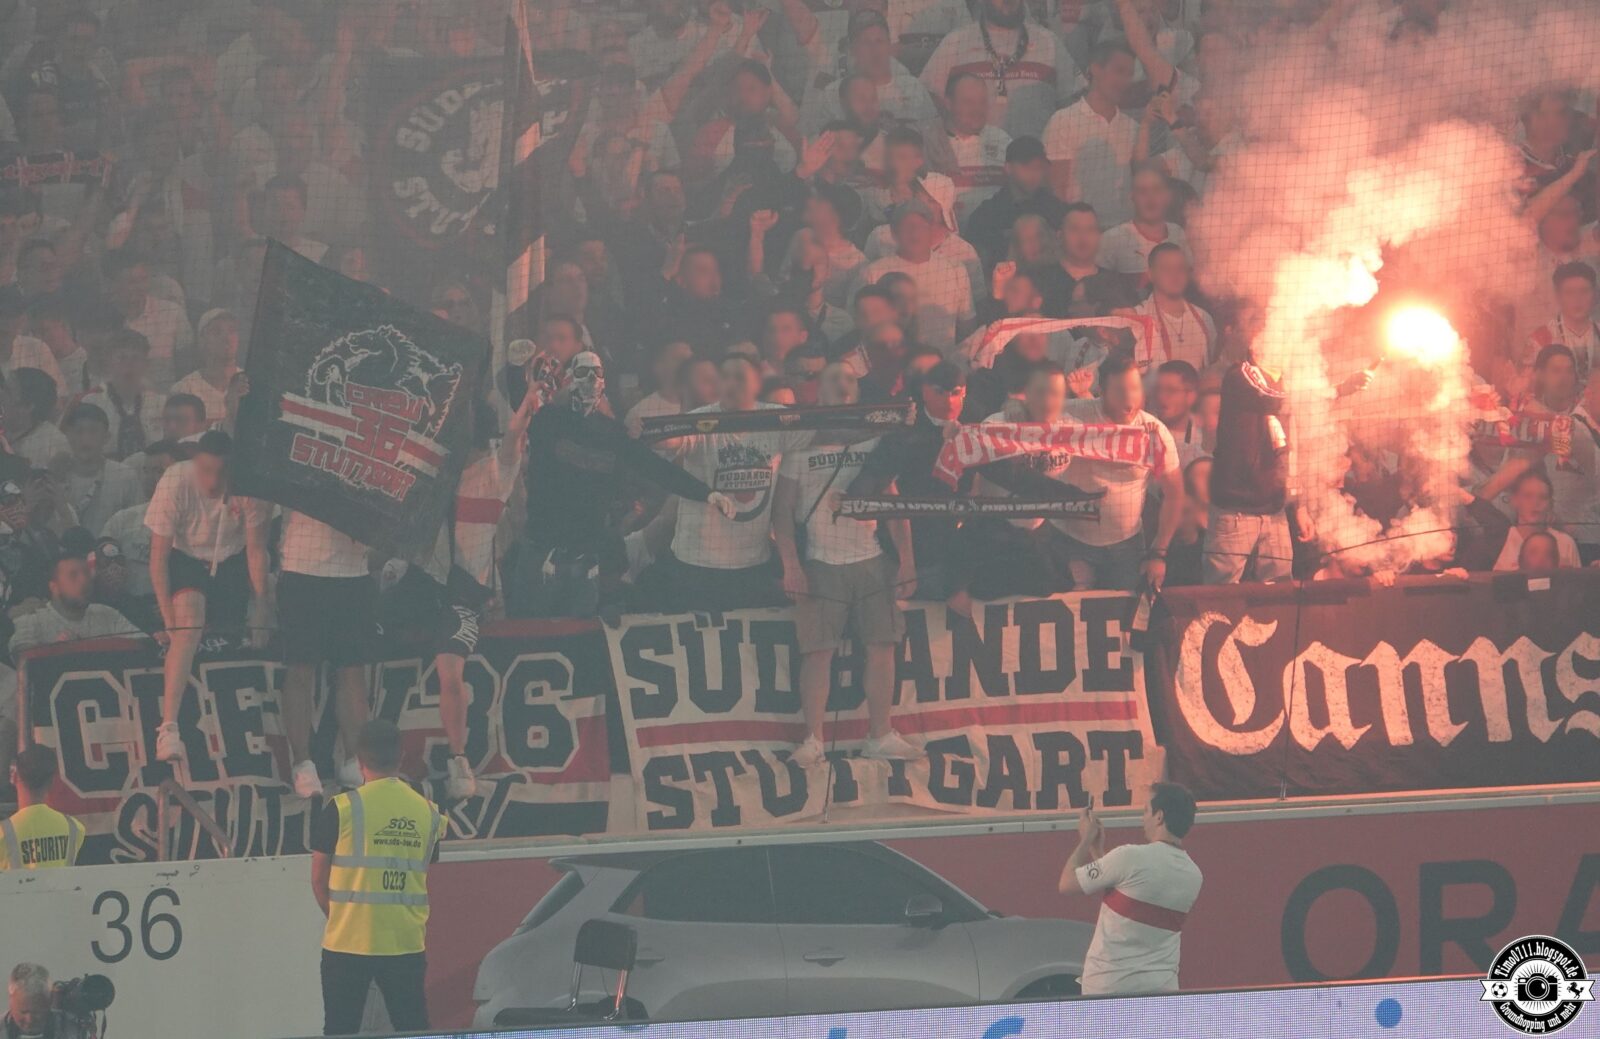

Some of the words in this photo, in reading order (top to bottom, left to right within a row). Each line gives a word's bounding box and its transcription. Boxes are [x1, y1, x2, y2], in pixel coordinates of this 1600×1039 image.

[344, 404, 412, 466] 36
[388, 817, 416, 831] SDS
[382, 870, 406, 891] 0223
[91, 887, 183, 963] 36
